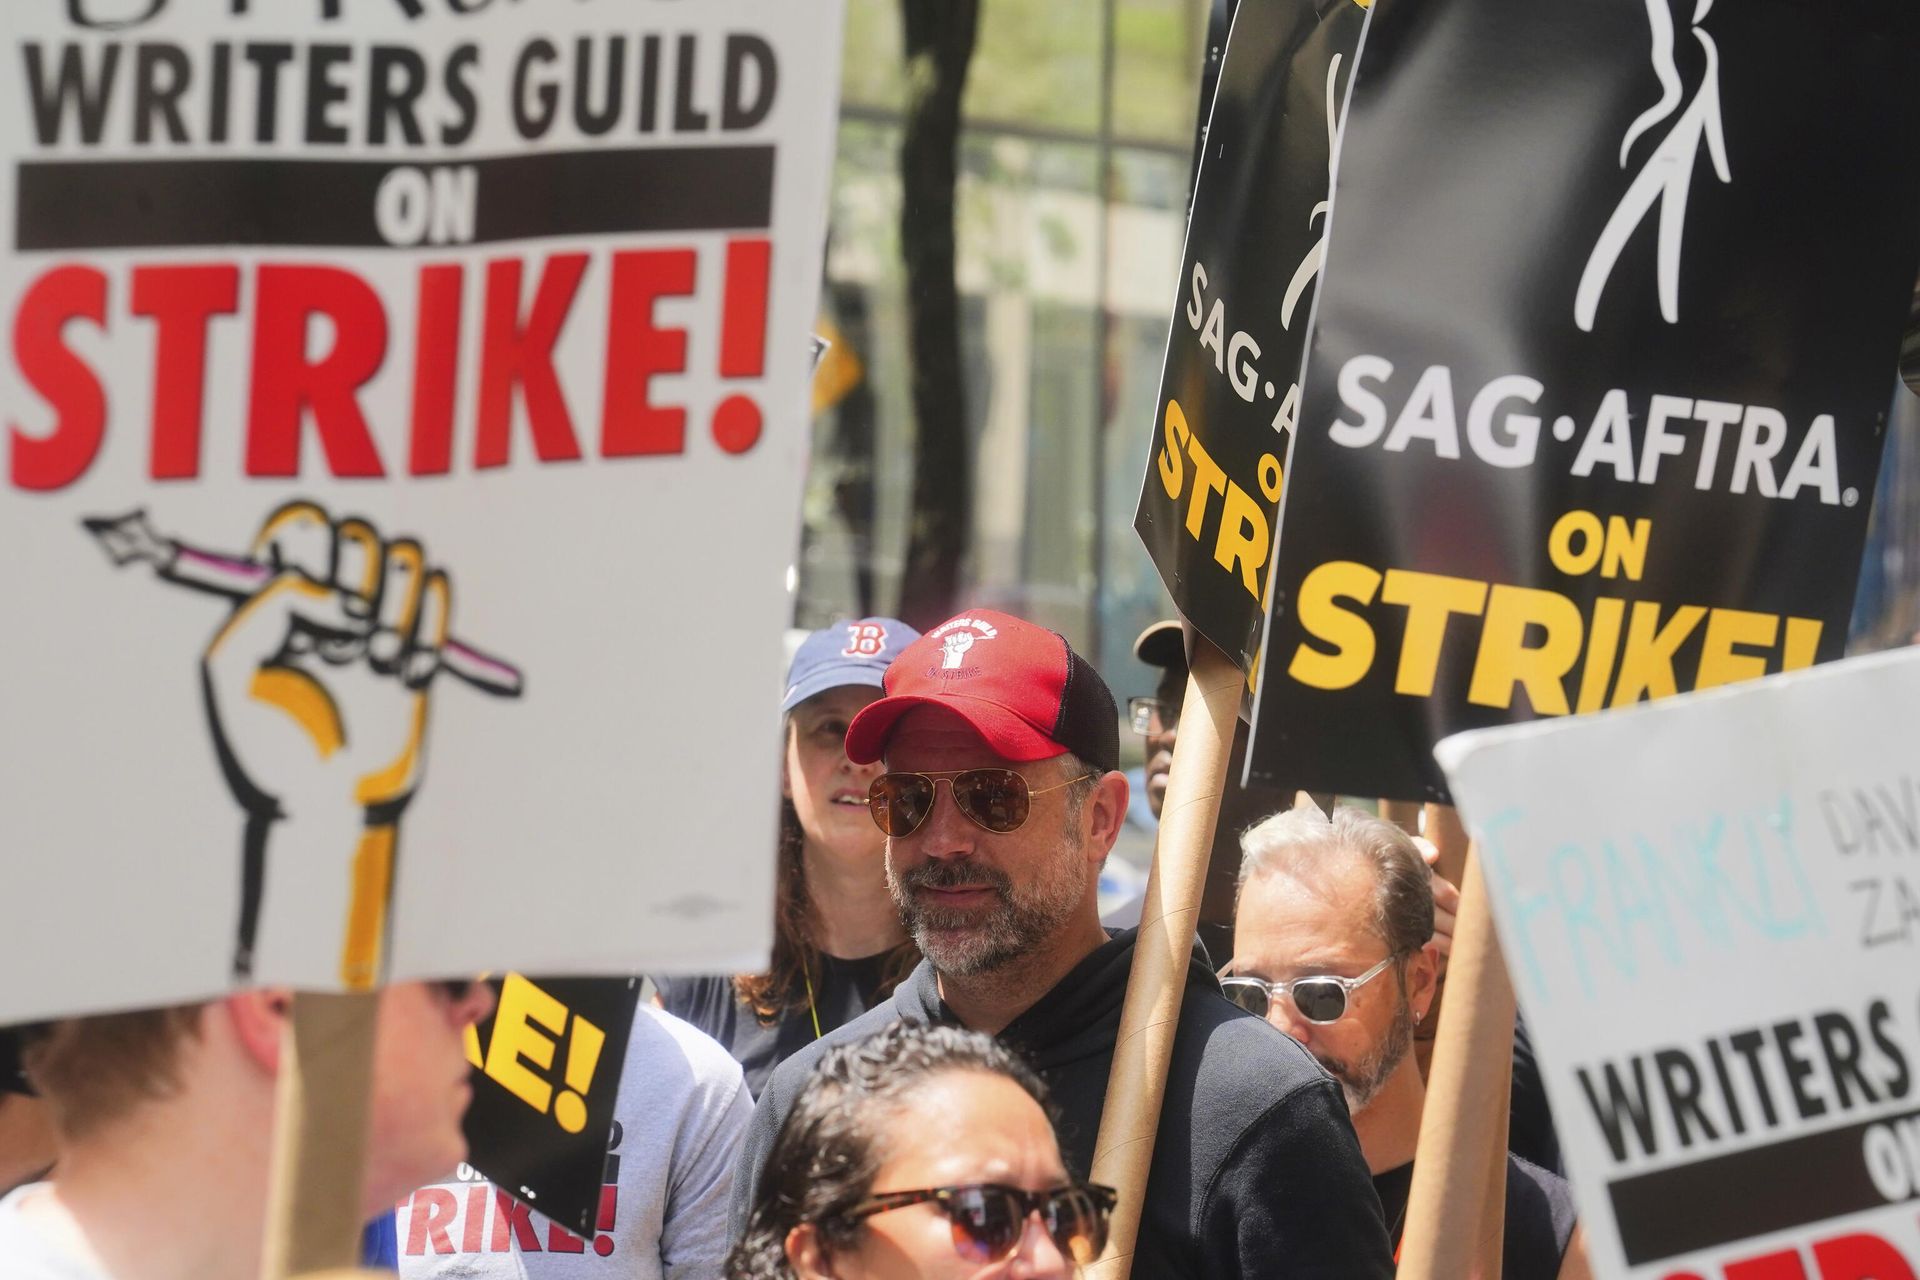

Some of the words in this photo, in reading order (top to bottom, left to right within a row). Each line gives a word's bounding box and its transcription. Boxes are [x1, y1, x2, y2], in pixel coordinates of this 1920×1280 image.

[22, 38, 480, 147] WRITERS
[510, 34, 780, 141] GUILD
[374, 165, 480, 247] ON
[8, 236, 773, 493] STRIKE!
[1158, 399, 1278, 602] STR
[1257, 453, 1283, 503] O
[1548, 510, 1652, 581] ON
[841, 621, 888, 658] B
[464, 970, 606, 1135] E!
[1577, 1000, 1910, 1163] WRITERS
